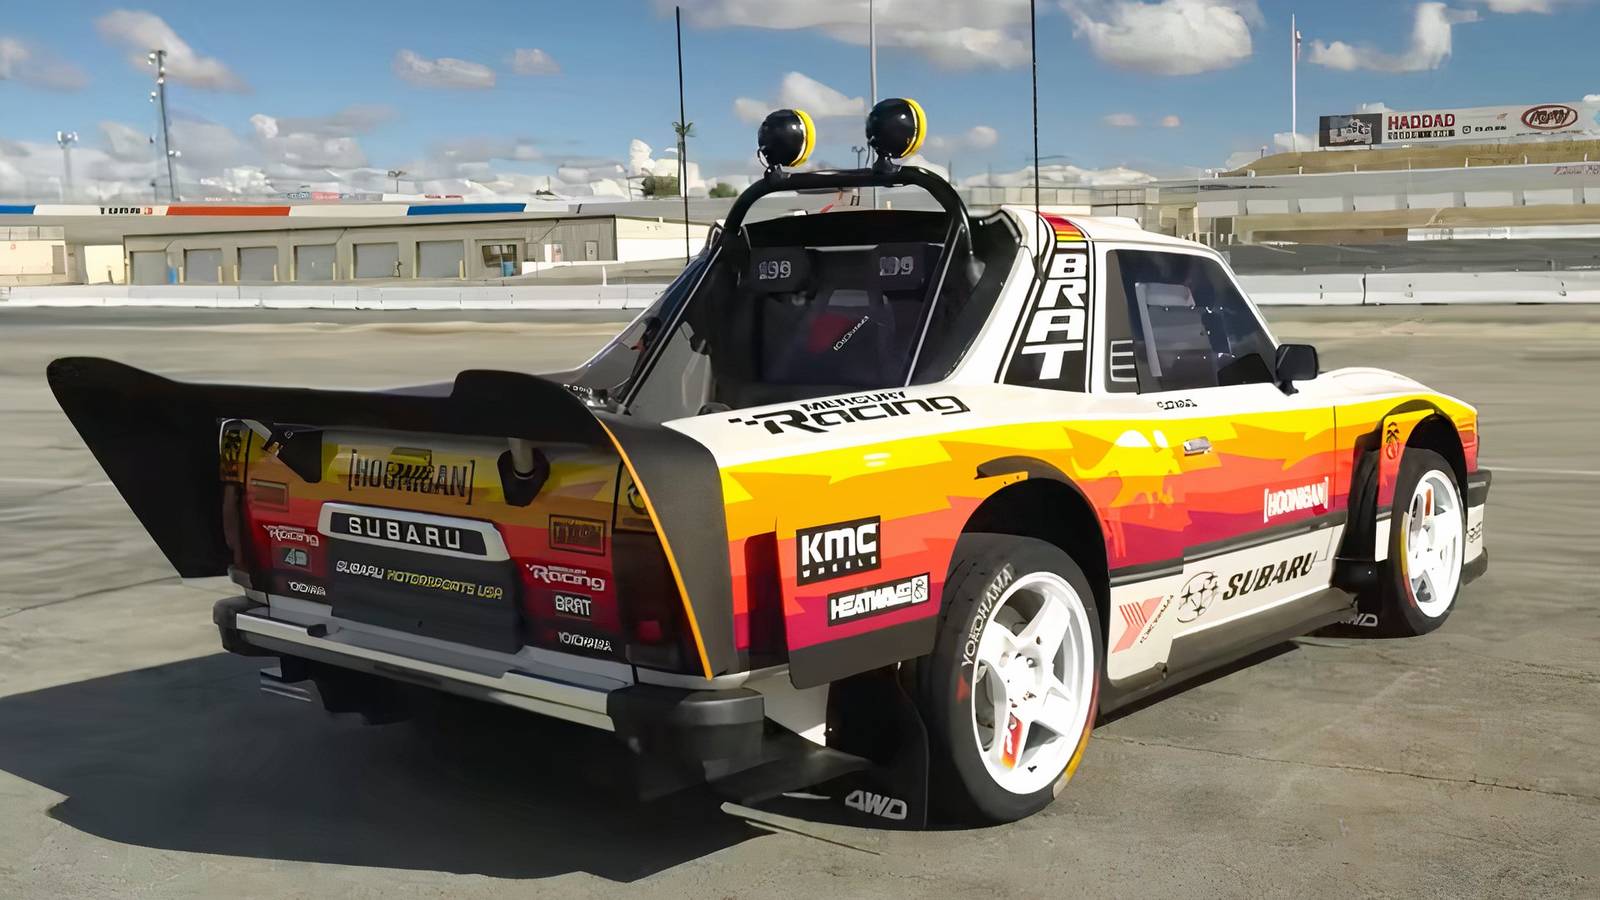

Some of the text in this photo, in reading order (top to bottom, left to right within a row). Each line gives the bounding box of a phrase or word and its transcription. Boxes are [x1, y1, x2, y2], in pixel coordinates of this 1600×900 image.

[1387, 114, 1455, 130] HADDAD
[1021, 253, 1088, 380] BRAT
[349, 516, 462, 549] SUBARU
[1222, 551, 1318, 601] SUBARU
[555, 595, 592, 616] BRAT
